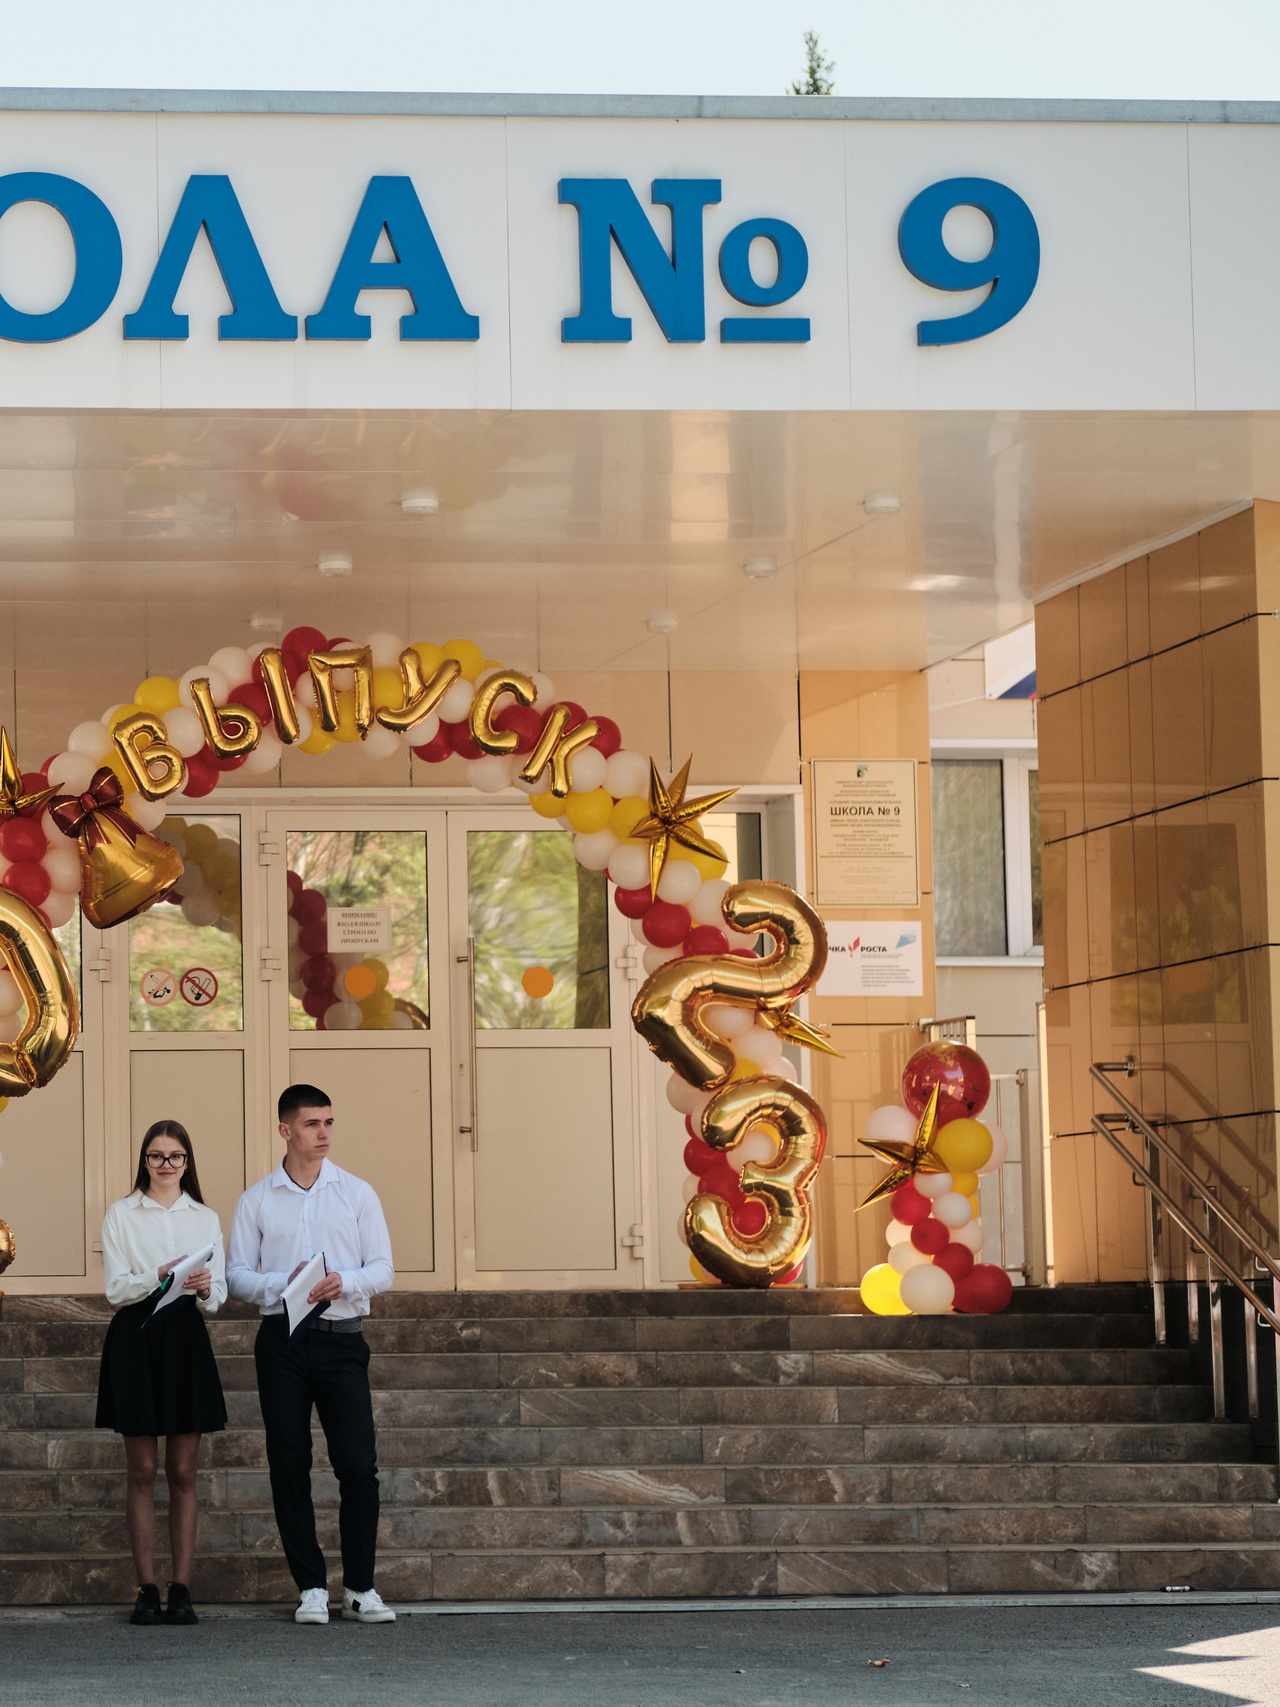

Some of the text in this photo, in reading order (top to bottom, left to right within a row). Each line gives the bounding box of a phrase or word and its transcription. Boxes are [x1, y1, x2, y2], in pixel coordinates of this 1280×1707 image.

[557, 177, 811, 345] №
[897, 176, 1041, 347] 9
[112, 644, 601, 802] ВЫПУСК
[830, 806, 900, 816] ШКОЛА № 9
